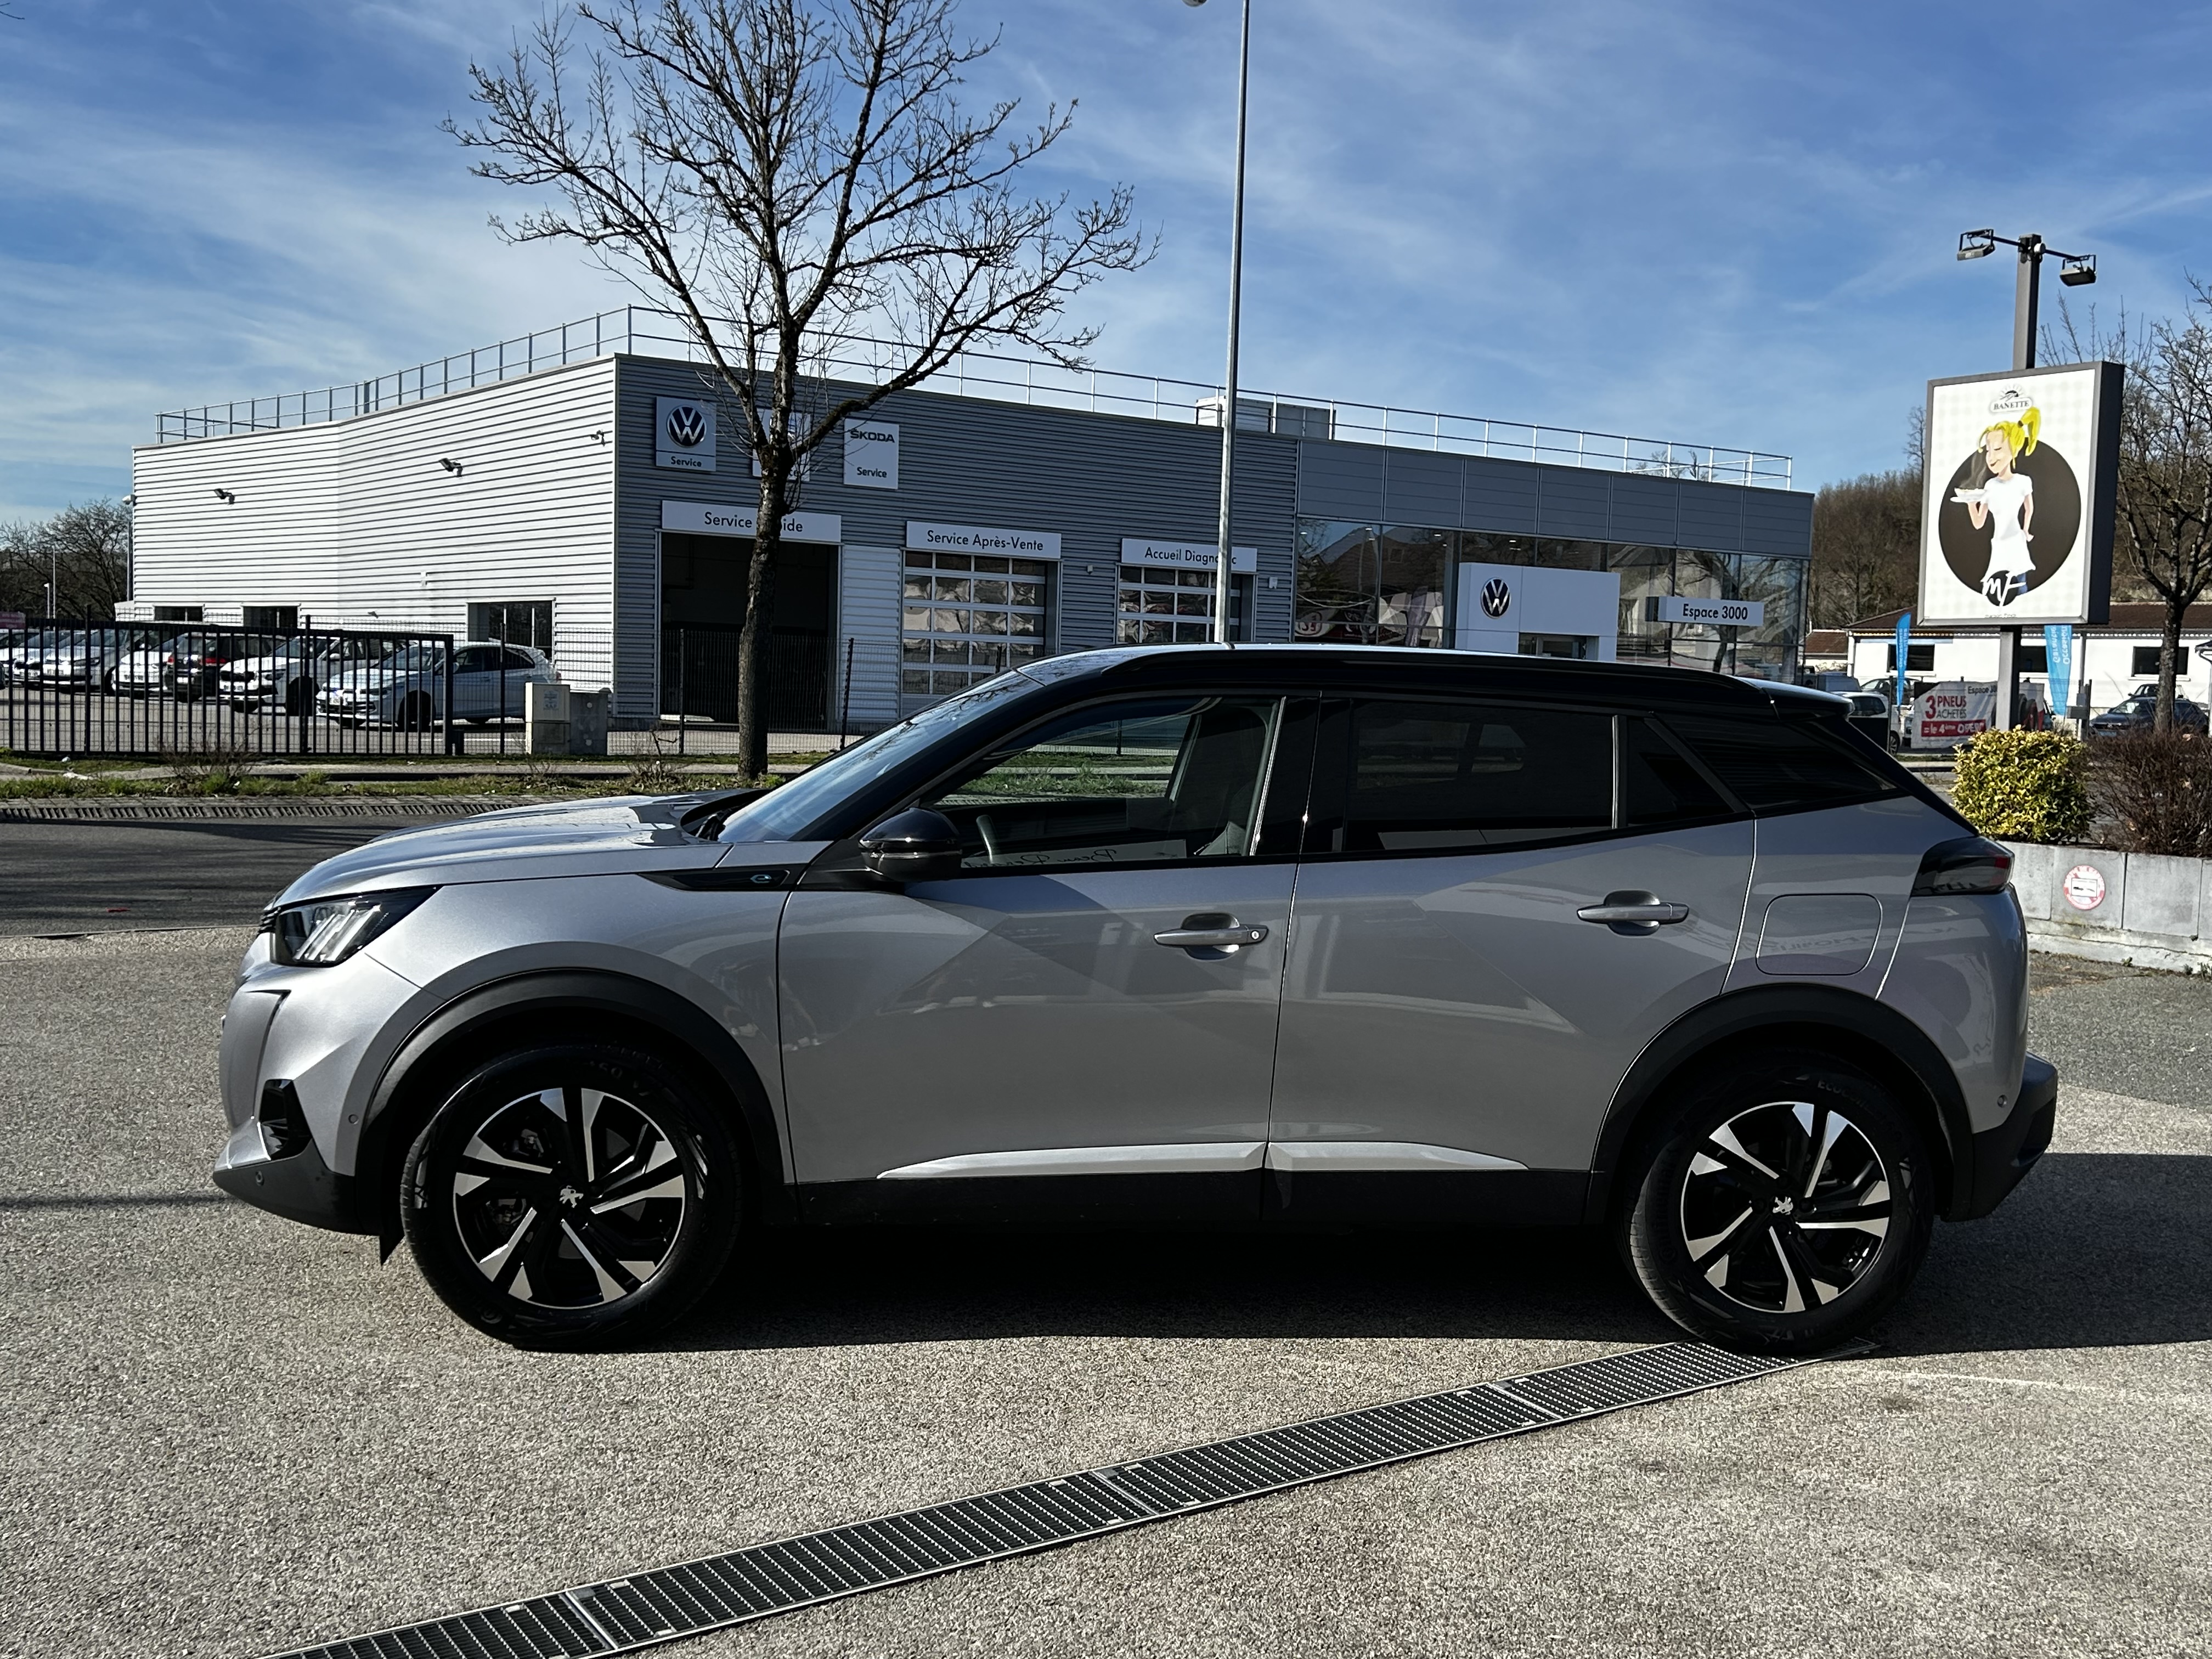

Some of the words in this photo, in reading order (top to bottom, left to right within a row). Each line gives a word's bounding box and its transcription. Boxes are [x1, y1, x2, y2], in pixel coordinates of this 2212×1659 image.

[1994, 400, 2029, 410] BANETTE
[850, 428, 895, 443] ŠKODA
[670, 456, 702, 467] Service
[856, 466, 888, 478] Service
[704, 511, 753, 528] Service
[783, 518, 803, 532] ide
[927, 529, 969, 545] Service
[972, 533, 1044, 551] Après-Vente
[1144, 546, 1182, 561] Accueil
[1185, 550, 1237, 566] Diagnoc
[1683, 603, 1719, 620] Espace
[1722, 606, 1748, 620] 3000
[1968, 686, 1989, 696] Espace
[1925, 695, 1936, 719] 3
[1937, 696, 1967, 708] PNEUS
